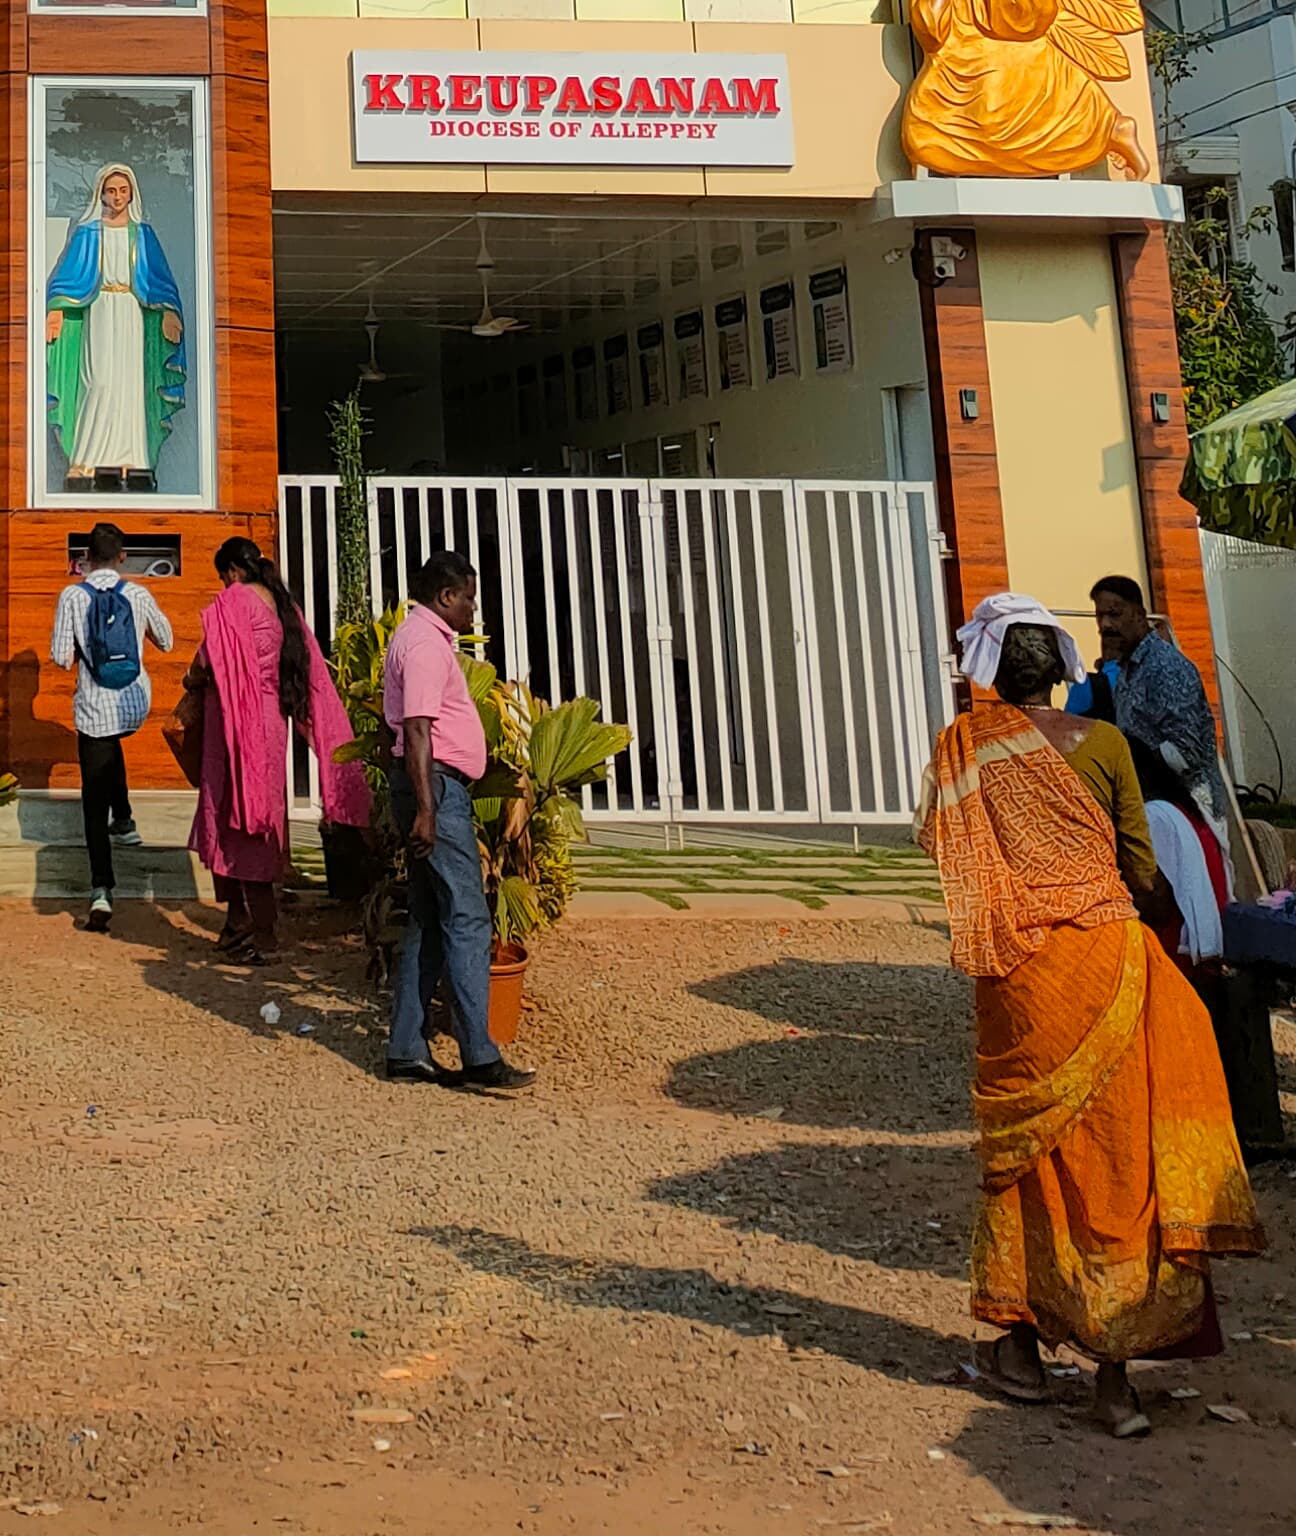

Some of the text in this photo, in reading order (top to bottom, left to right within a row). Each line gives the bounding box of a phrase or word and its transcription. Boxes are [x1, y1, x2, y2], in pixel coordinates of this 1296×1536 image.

[363, 73, 781, 114] KREUPASANAM
[429, 120, 718, 140] DIOCESE OF ALLEPPEY
